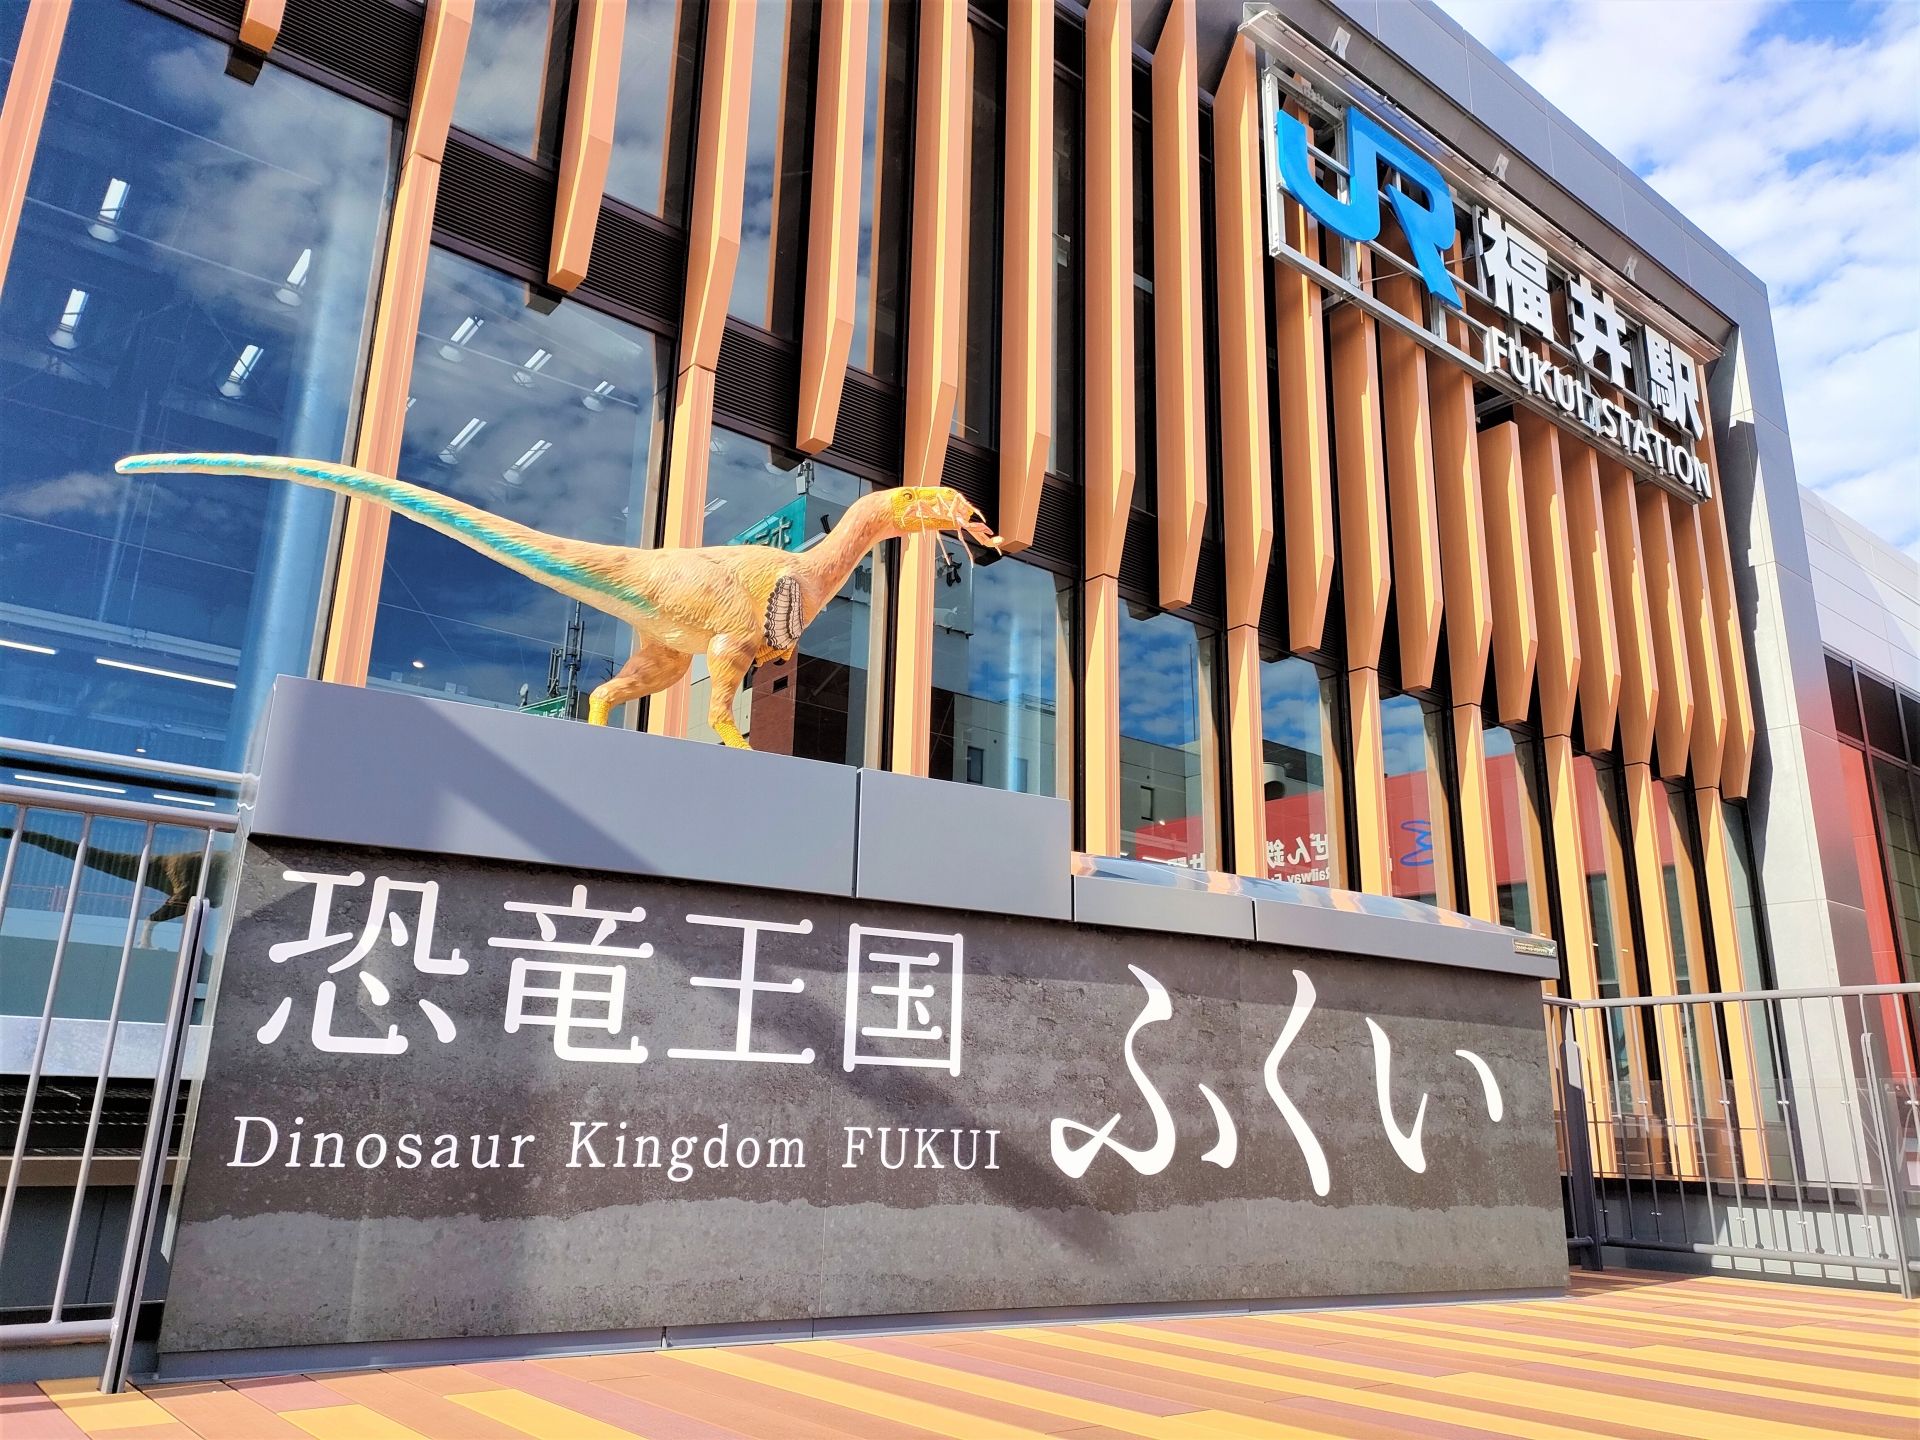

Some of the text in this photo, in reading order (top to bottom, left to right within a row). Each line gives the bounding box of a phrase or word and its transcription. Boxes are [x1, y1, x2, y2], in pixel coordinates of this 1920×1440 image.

[1277, 106, 1462, 309] JR
[1479, 207, 1704, 441] 福井駅
[1485, 326, 1712, 499] FUKUI STATION
[257, 869, 1503, 1197] 恐竜王国 ふくい
[227, 1116, 1002, 1182] Dinosaur Kingdom FUKUI
